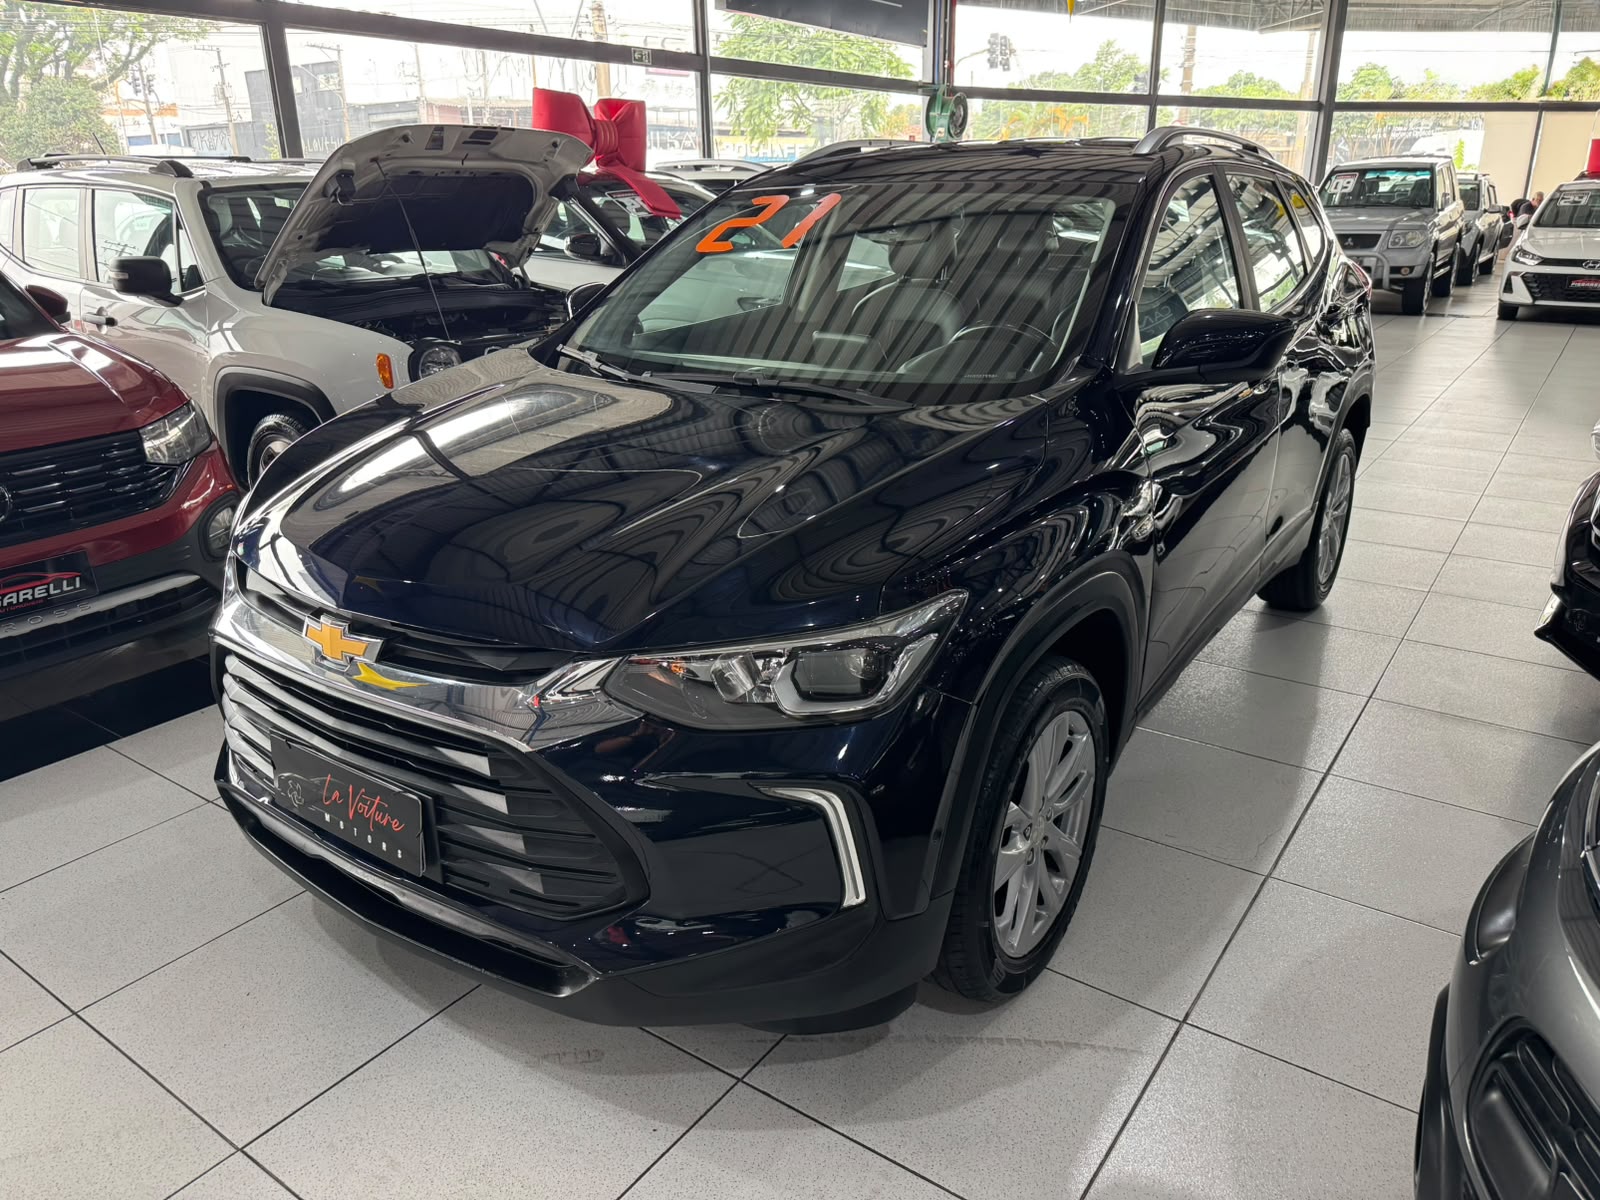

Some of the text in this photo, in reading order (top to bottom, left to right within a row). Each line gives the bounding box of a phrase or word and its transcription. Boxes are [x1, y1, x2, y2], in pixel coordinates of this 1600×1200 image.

[1331, 178, 1355, 193] 09
[695, 193, 842, 253] 21
[0, 576, 81, 608] ARELLI
[322, 773, 405, 831] La Voiture
[324, 812, 402, 858] MOTORS
